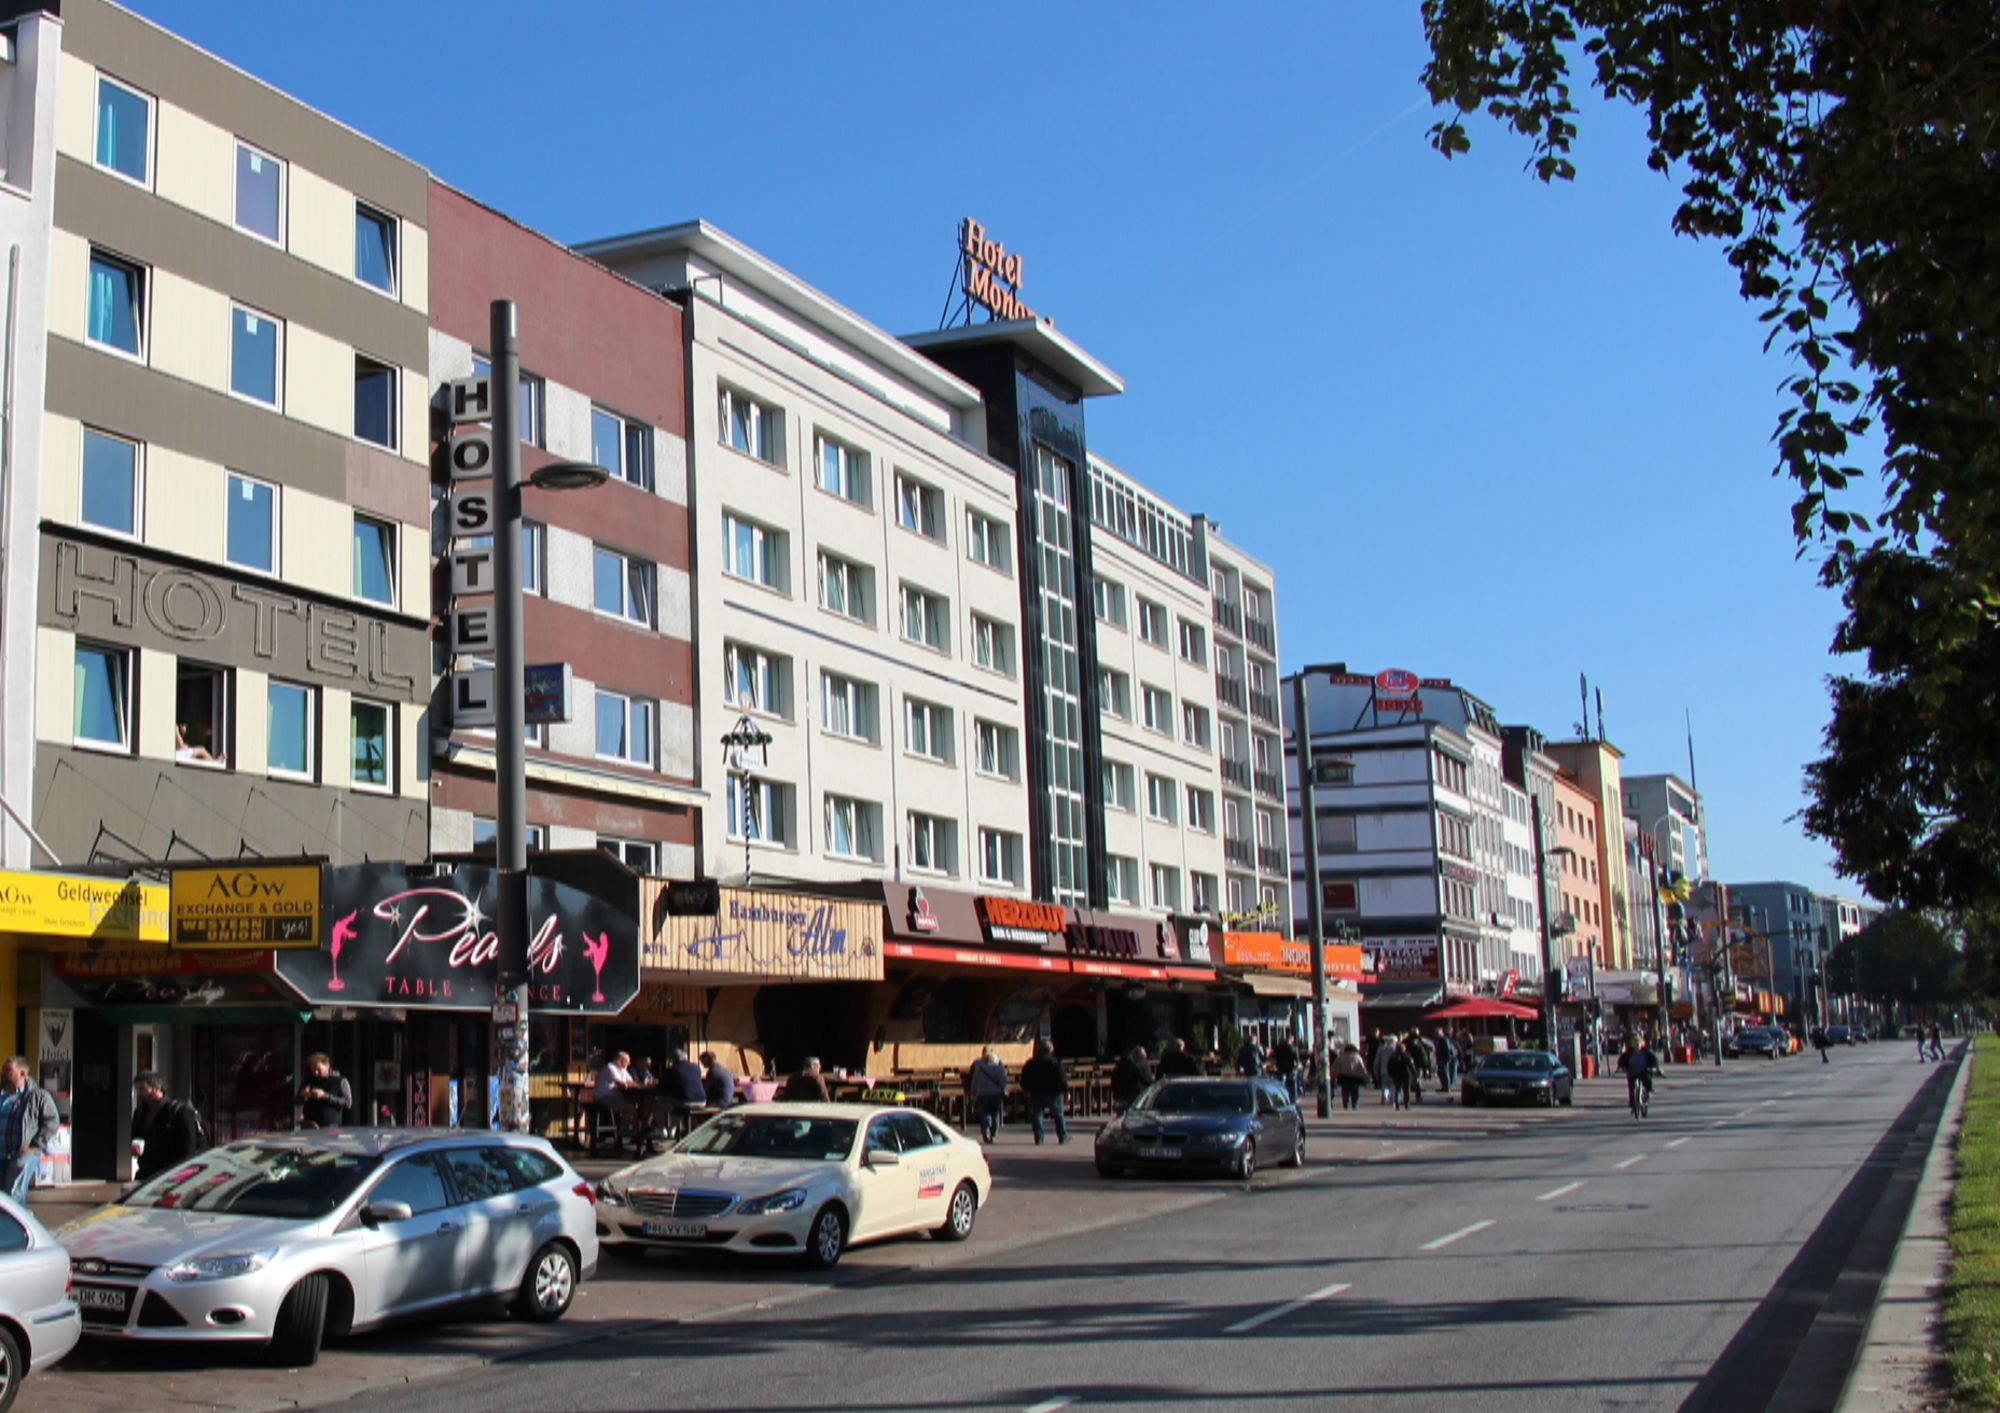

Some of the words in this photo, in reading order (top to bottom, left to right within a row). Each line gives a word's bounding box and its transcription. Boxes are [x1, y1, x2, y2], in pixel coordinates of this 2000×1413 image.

[964, 216, 1023, 289] Hotel
[453, 383, 490, 711] HOSTEL
[55, 541, 414, 700] HOTEL
[58, 881, 148, 906] Geldwechsel
[177, 904, 254, 915] EXCHANGE
[259, 904, 268, 914] &
[273, 901, 313, 913] GOLD
[89, 899, 168, 932] Exchang
[182, 918, 262, 931] WESTERN
[730, 900, 807, 929] Hamburger
[985, 898, 1067, 933] HERZBLUT
[207, 931, 262, 942] UNION
[373, 887, 564, 974] Peals
[788, 904, 847, 957] Alm
[385, 976, 452, 997] TABLE
[41, 1047, 70, 1061] Hotel
